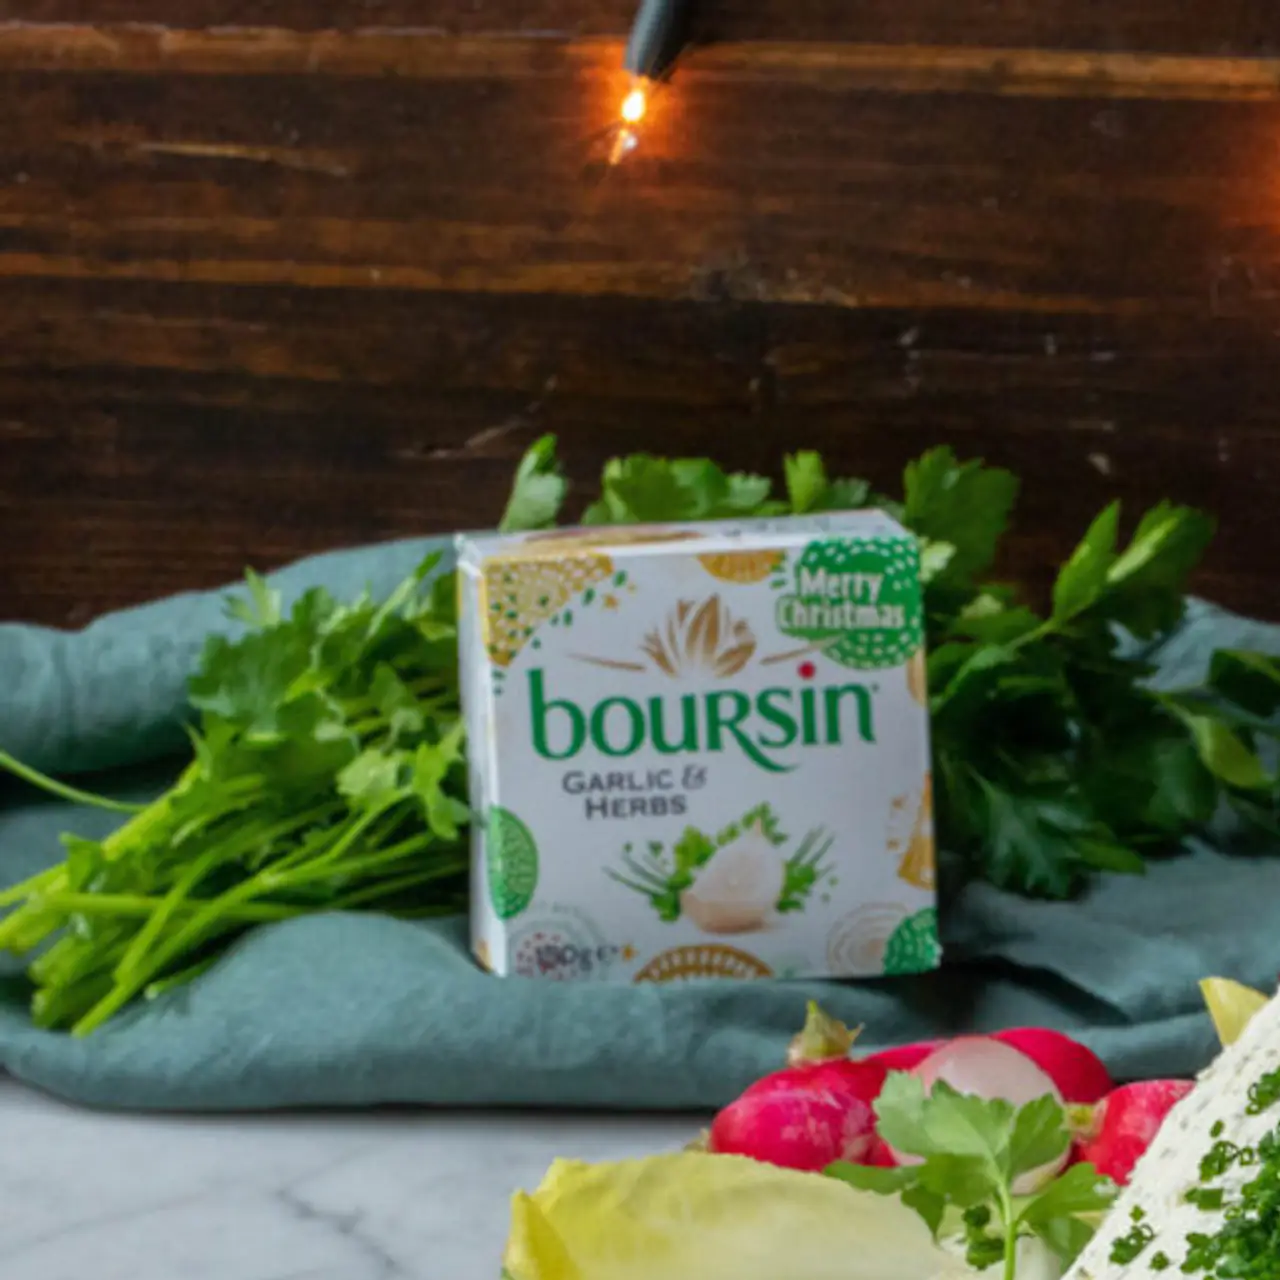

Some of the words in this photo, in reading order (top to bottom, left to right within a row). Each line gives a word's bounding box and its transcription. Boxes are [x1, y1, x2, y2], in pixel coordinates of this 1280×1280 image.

[800, 567, 884, 604] Merry
[778, 600, 905, 629] Christmas
[562, 769, 674, 795] GARLIC
[585, 794, 688, 820] HERBS
